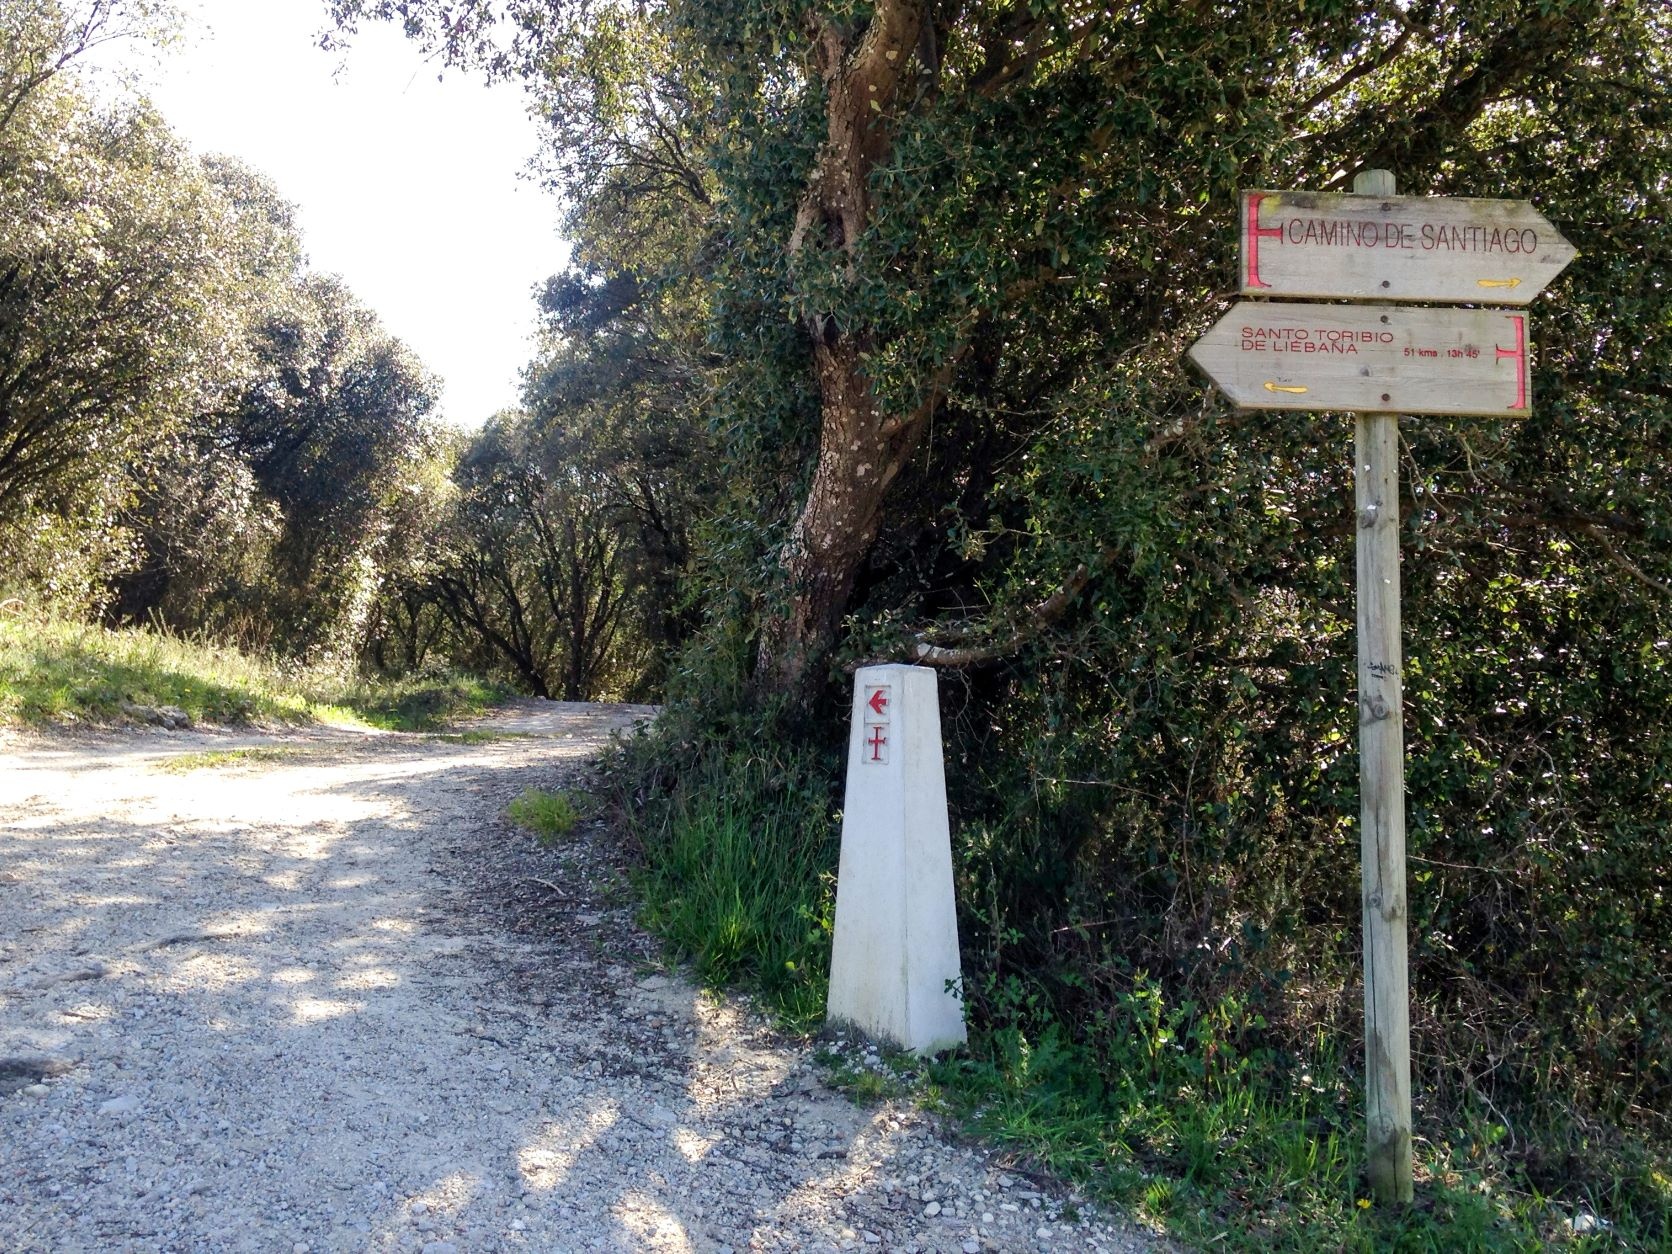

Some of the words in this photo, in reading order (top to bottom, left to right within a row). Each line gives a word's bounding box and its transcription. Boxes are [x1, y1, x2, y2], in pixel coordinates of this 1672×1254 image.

[1288, 218, 1379, 247] CAMINO
[1386, 223, 1413, 249] DE
[1421, 224, 1538, 254] SANTIAGO
[1241, 327, 1309, 340] SANTO
[1315, 330, 1394, 343] TORIBIO
[1241, 340, 1266, 351] DE
[1403, 348, 1414, 357] 51
[1418, 348, 1438, 358] kms
[1447, 349, 1463, 358] 13h
